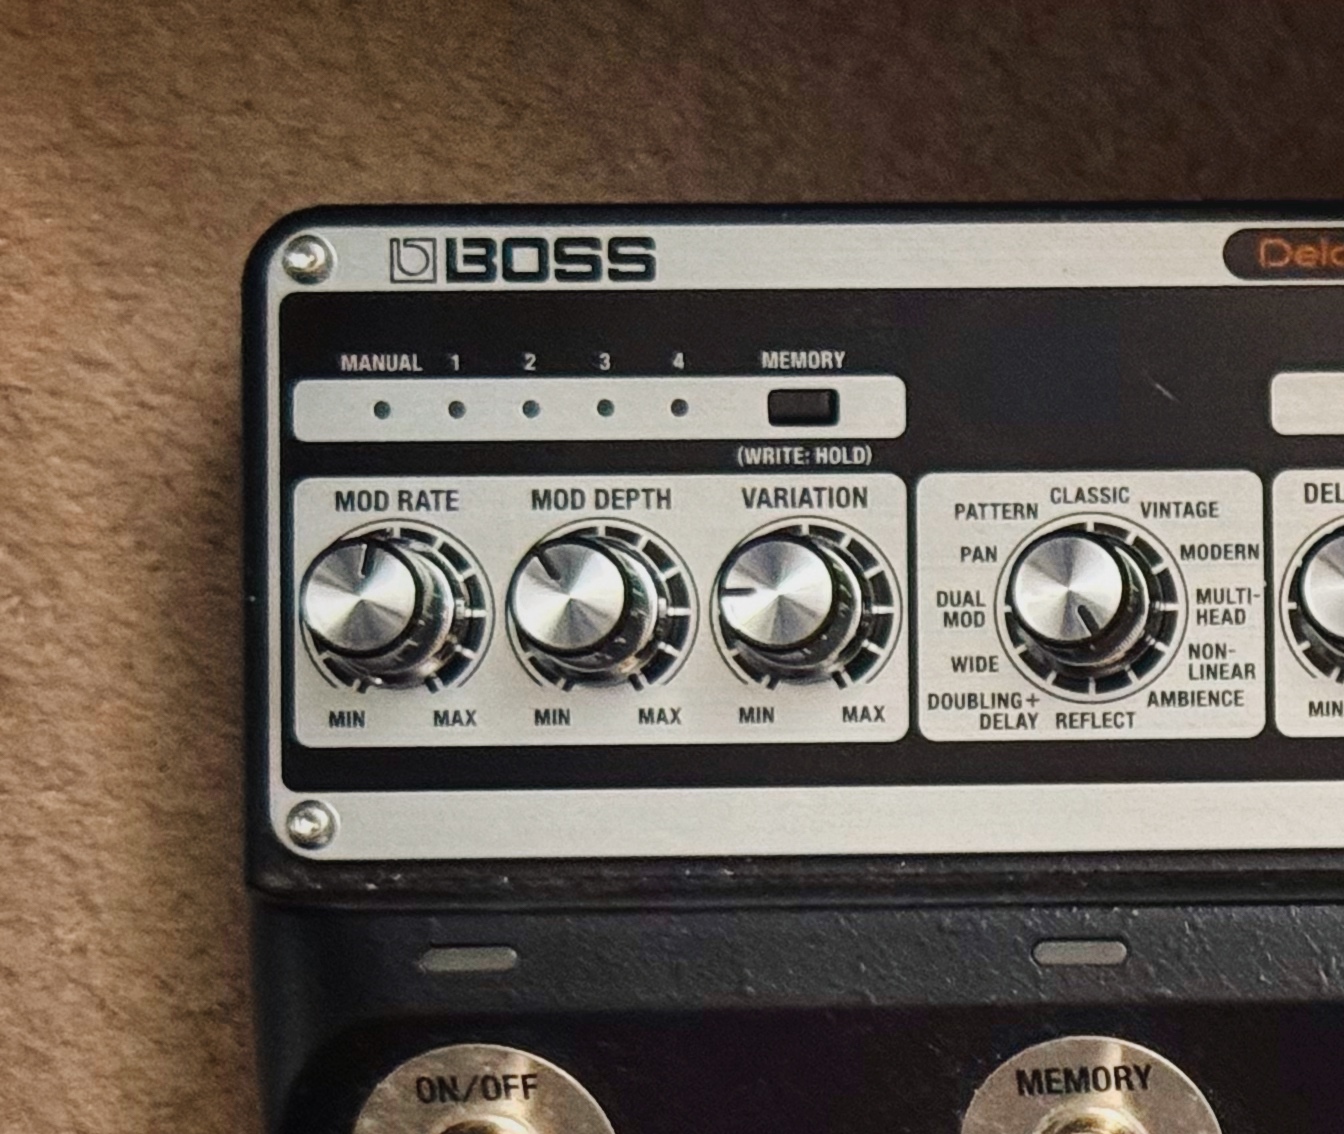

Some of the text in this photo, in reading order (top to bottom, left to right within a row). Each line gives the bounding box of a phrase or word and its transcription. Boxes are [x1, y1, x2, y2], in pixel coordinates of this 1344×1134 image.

[446, 236, 657, 284] BOSS
[340, 353, 423, 373] MANUAL
[450, 353, 460, 371] 1
[523, 352, 537, 371] 2
[599, 352, 611, 370] 3
[672, 352, 686, 370] 4
[760, 350, 845, 371] MEMORY
[736, 446, 873, 467] (WRITE: HOLD)
[334, 490, 459, 513] MOD RATE
[531, 489, 672, 511] MOD DEPTH
[741, 487, 868, 510] VARIATION
[1050, 486, 1131, 504] CLASSIC
[954, 503, 1039, 521] PATTERN
[1140, 501, 1220, 519] VINTAGE
[960, 546, 998, 563] PAN
[1180, 544, 1260, 561] MODERN
[936, 590, 986, 608] DUAL
[1195, 588, 1261, 605] MULTI-
[943, 611, 986, 628] MOD
[1196, 608, 1246, 626] HEAD
[1188, 643, 1236, 660] NON-
[950, 656, 1000, 674] WIDE
[1188, 663, 1257, 680] LINEAR
[1147, 691, 1245, 708] AMBIENCE
[534, 708, 571, 727] MIN
[638, 707, 682, 726] MAX
[739, 706, 775, 725] MIN
[842, 705, 886, 724] MAX
[1308, 700, 1344, 718] MIN
[328, 710, 366, 729] MIN
[433, 709, 477, 728] MAX
[979, 713, 1039, 730] DELAY
[1055, 712, 1136, 729] REFLECT
[414, 1071, 539, 1108] ON/OFF
[1015, 1063, 1154, 1101] MEMORY
